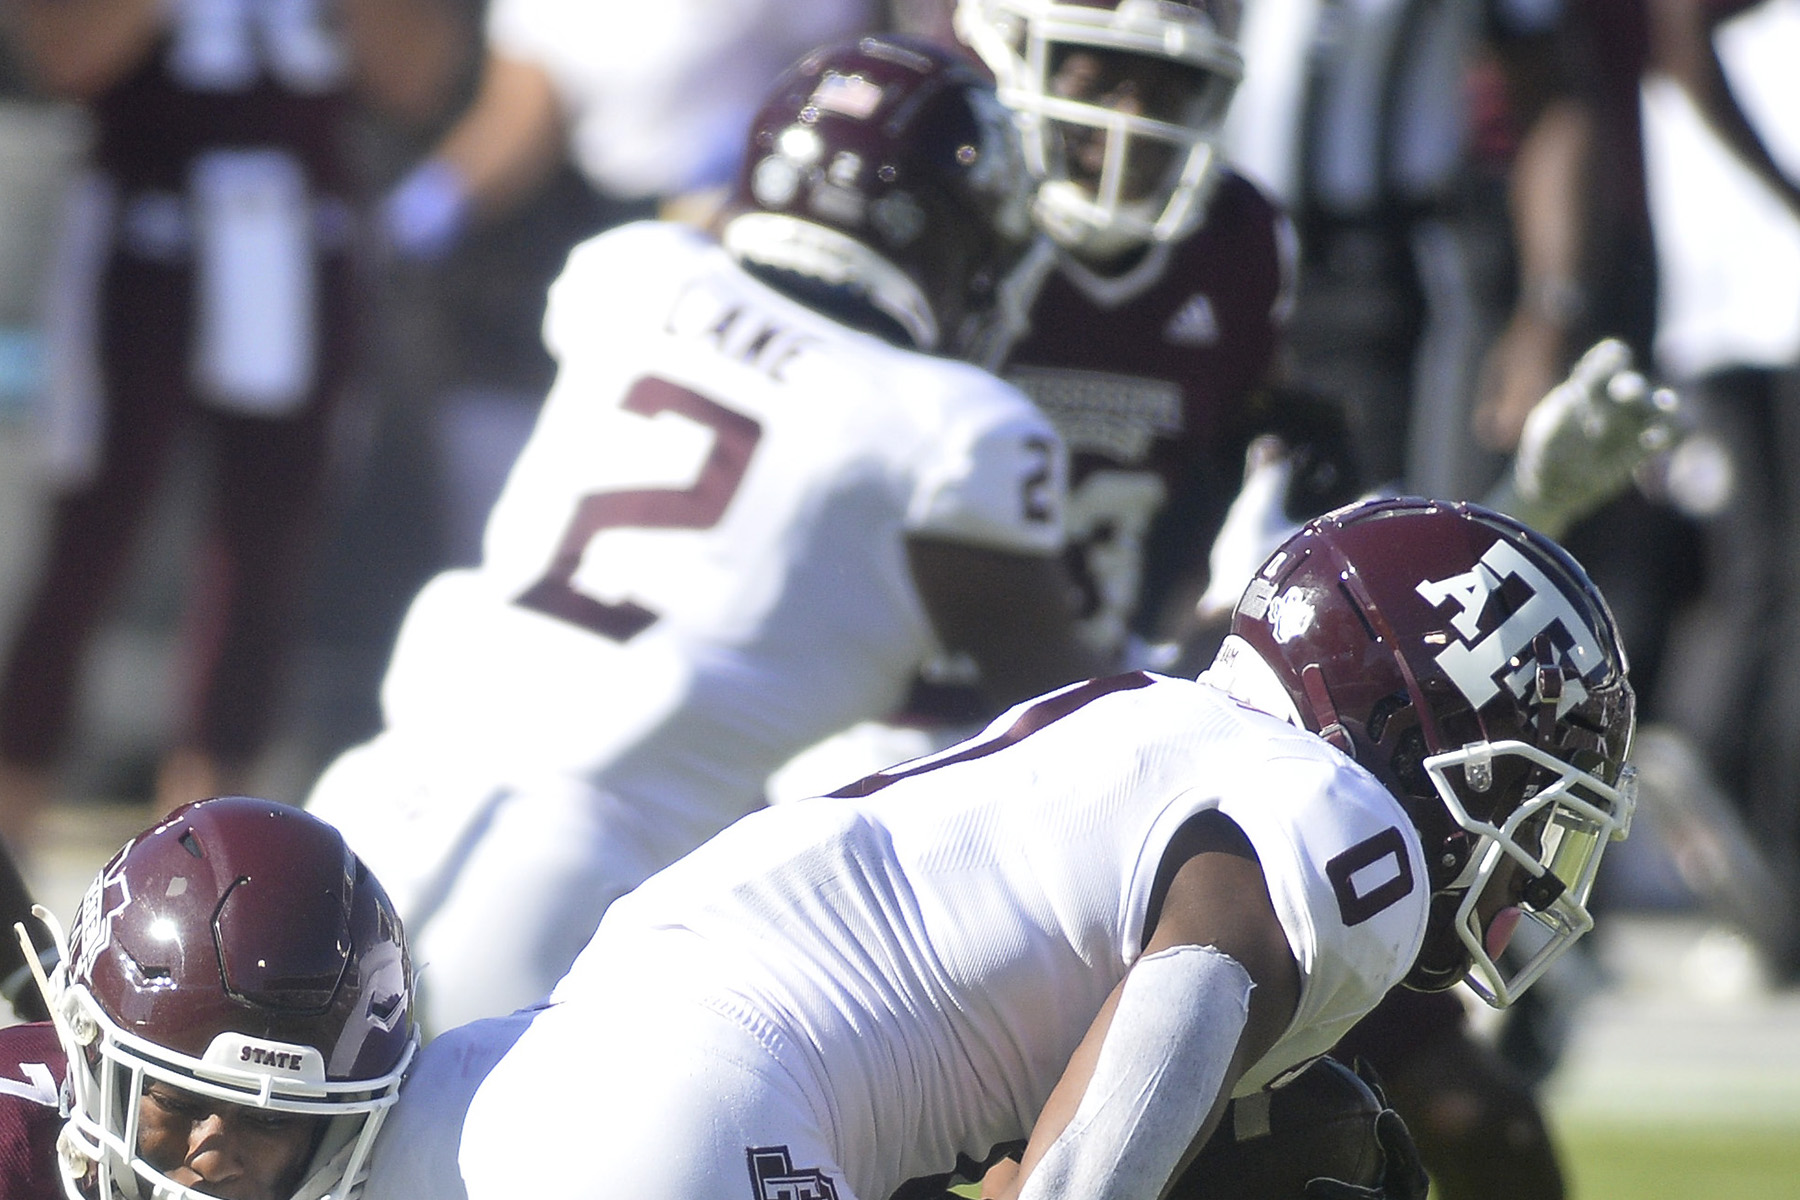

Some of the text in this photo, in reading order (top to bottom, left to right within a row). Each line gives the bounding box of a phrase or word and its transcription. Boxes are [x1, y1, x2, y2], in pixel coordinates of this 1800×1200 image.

[507, 375, 763, 642] 2
[1325, 825, 1415, 928] 0
[240, 1045, 303, 1071] STATE
